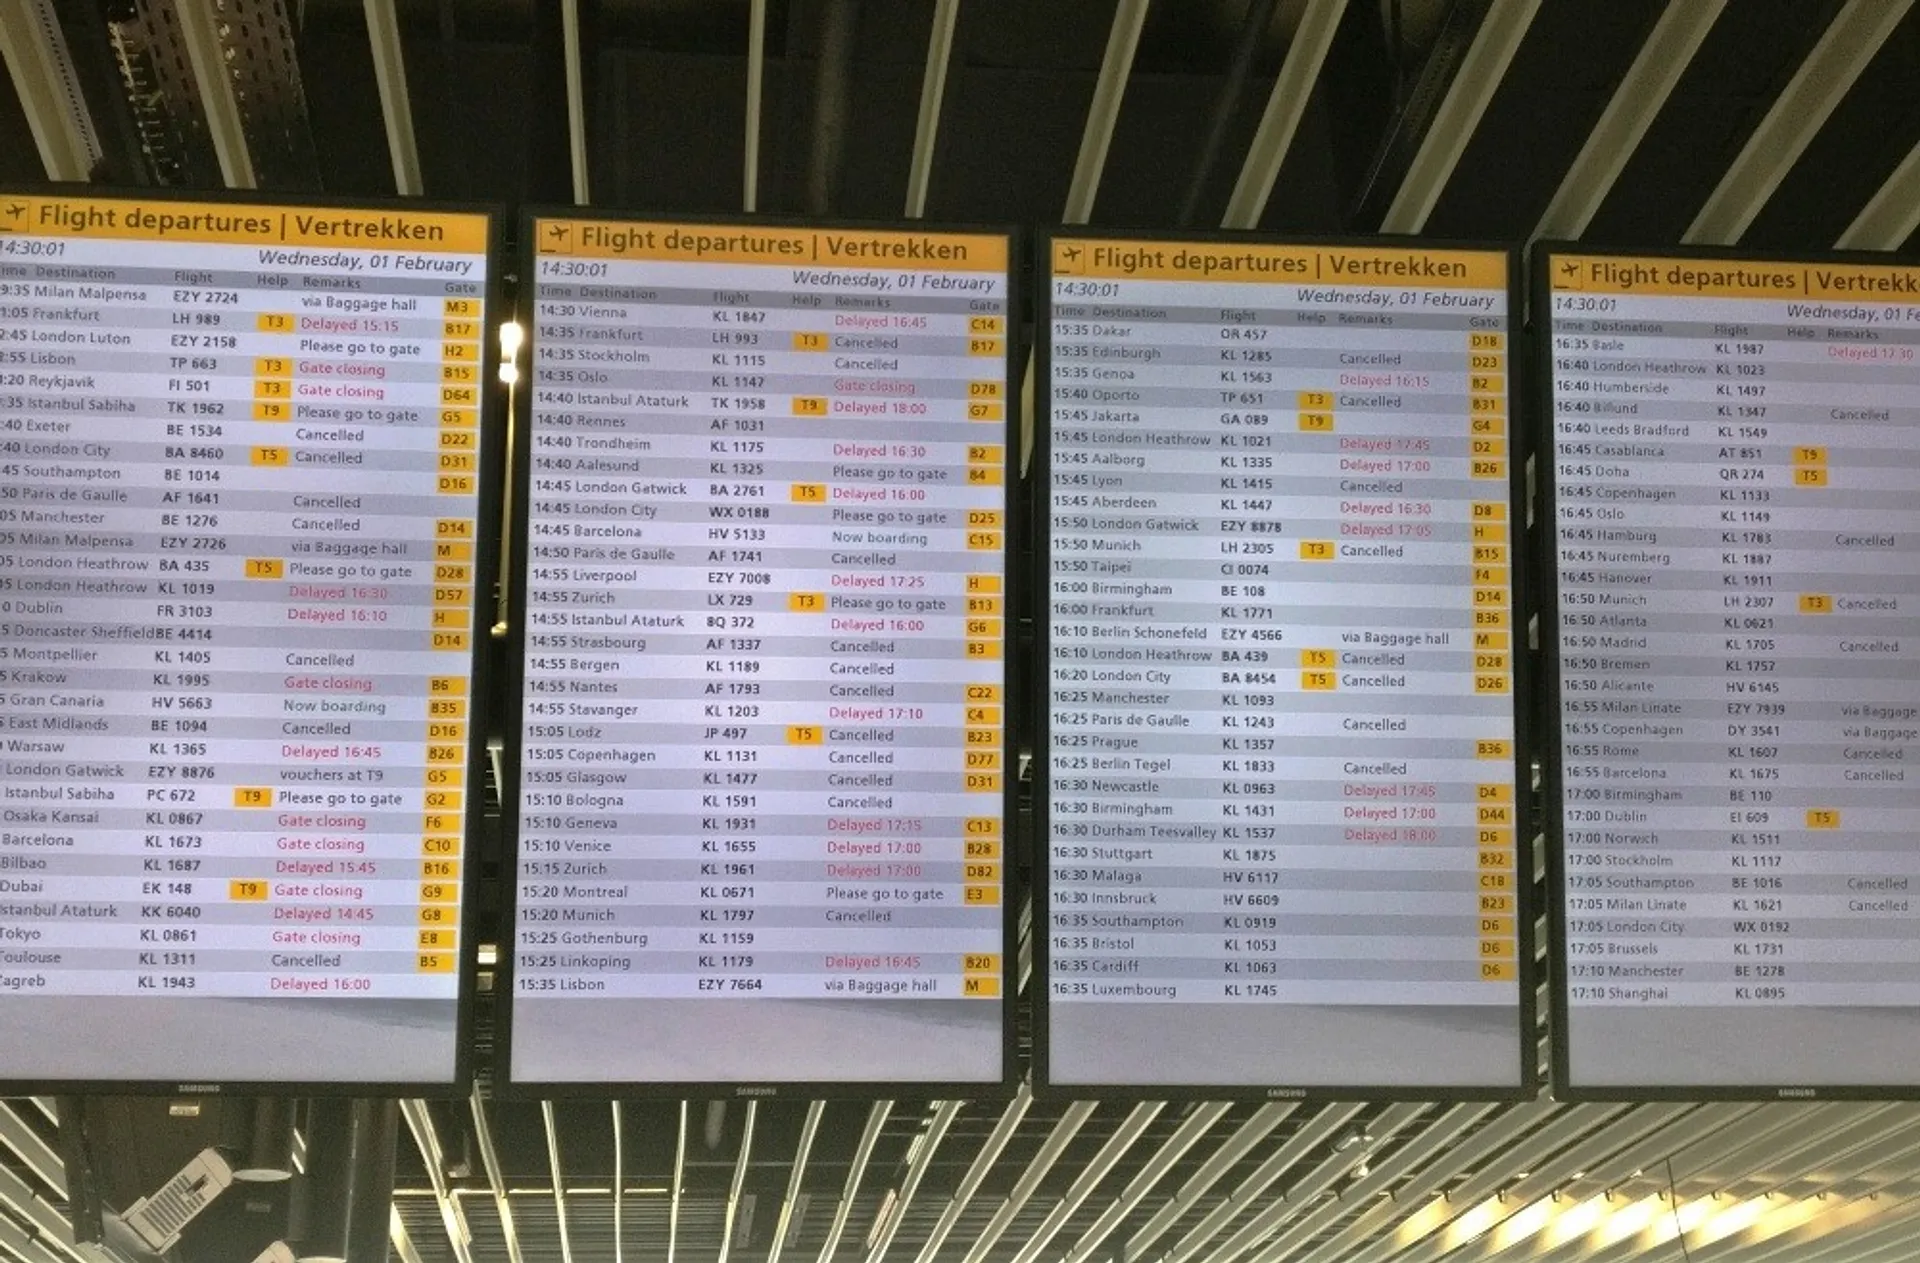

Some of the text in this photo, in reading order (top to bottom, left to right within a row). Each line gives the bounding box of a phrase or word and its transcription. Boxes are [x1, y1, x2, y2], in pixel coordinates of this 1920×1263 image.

[40, 204, 443, 241] Flight departures Vertrekken
[582, 226, 967, 260] Flight departures Vertrekken
[259, 249, 473, 276] Wednesday, 01 February
[542, 261, 608, 277] 14:30:01
[1094, 247, 1466, 278] Flight departures Vertrekken
[36, 265, 477, 293] Destination Flight Help Remarks Gate
[793, 271, 996, 294] Wednesday, 01 February
[1591, 263, 1920, 293] Flight departures Vertrekk
[34, 285, 468, 312] Milan Malpensa EZY 2724 via Baggage hall M3
[1056, 282, 1119, 297] 14:30:01
[1297, 288, 1495, 311] Wednesday, 01 February
[1557, 297, 1616, 312] 14:30:01
[1787, 304, 1879, 324] Wednesday,
[1883, 307, 1900, 321] 01
[540, 304, 995, 330] 14:30 Vienna KL 1847 Delayed 16:45 C14
[1054, 304, 1500, 328] Time Destination Flight Help Remarks Gate
[1054, 388, 1088, 399] 15:40
[1092, 388, 1140, 402] Oporto
[1220, 392, 1237, 403] TP
[1308, 393, 1324, 405] T3
[1340, 394, 1402, 408] Cancelled
[1559, 443, 1591, 455] 16:45
[1718, 447, 1736, 458] AT
[1802, 449, 1817, 460] T9
[534, 524, 994, 548] 14:45 Barcelona HV 5133 Now boarding C15
[1560, 528, 1593, 540] 16:45
[1597, 529, 1657, 544] Hamburg
[1722, 532, 1737, 543] KL
[1835, 533, 1895, 547] Cancelled
[1563, 593, 1595, 604] 16:50
[1599, 593, 1647, 606] Munich
[1724, 596, 1740, 608] LH
[1807, 597, 1823, 608] T3
[1836, 597, 1897, 610] Cancelled
[15, 601, 445, 623] Dublin FR 3103 Delayed 16:10 H
[531, 635, 984, 654] 14:55 Strasbourg AF 1337 Cancelled B3
[1054, 647, 1502, 667] 16:10 London Heathrow BA 439 T5 Cancelled D28
[5, 786, 446, 808] Istanbul Sabiha PC 672 T9 Please go to gate G2
[1053, 802, 1505, 822] 16:30 Birmingham KL 1431 Delayed 17:00 D44
[1567, 810, 1601, 821] 17:00
[1605, 810, 1647, 823] Dublin
[1730, 812, 1742, 823] EI
[1814, 811, 1832, 823] T5
[2, 833, 451, 854] Barcelona KL 1673 Gate closing C10
[519, 977, 978, 994] 15:35 Lisbon EZY 7664 via Baggage hall M
[1052, 983, 1277, 999] 16:35 Luxembourg KL 1745
[1571, 987, 1785, 1002] 17:10 Shanghai KL 0895
